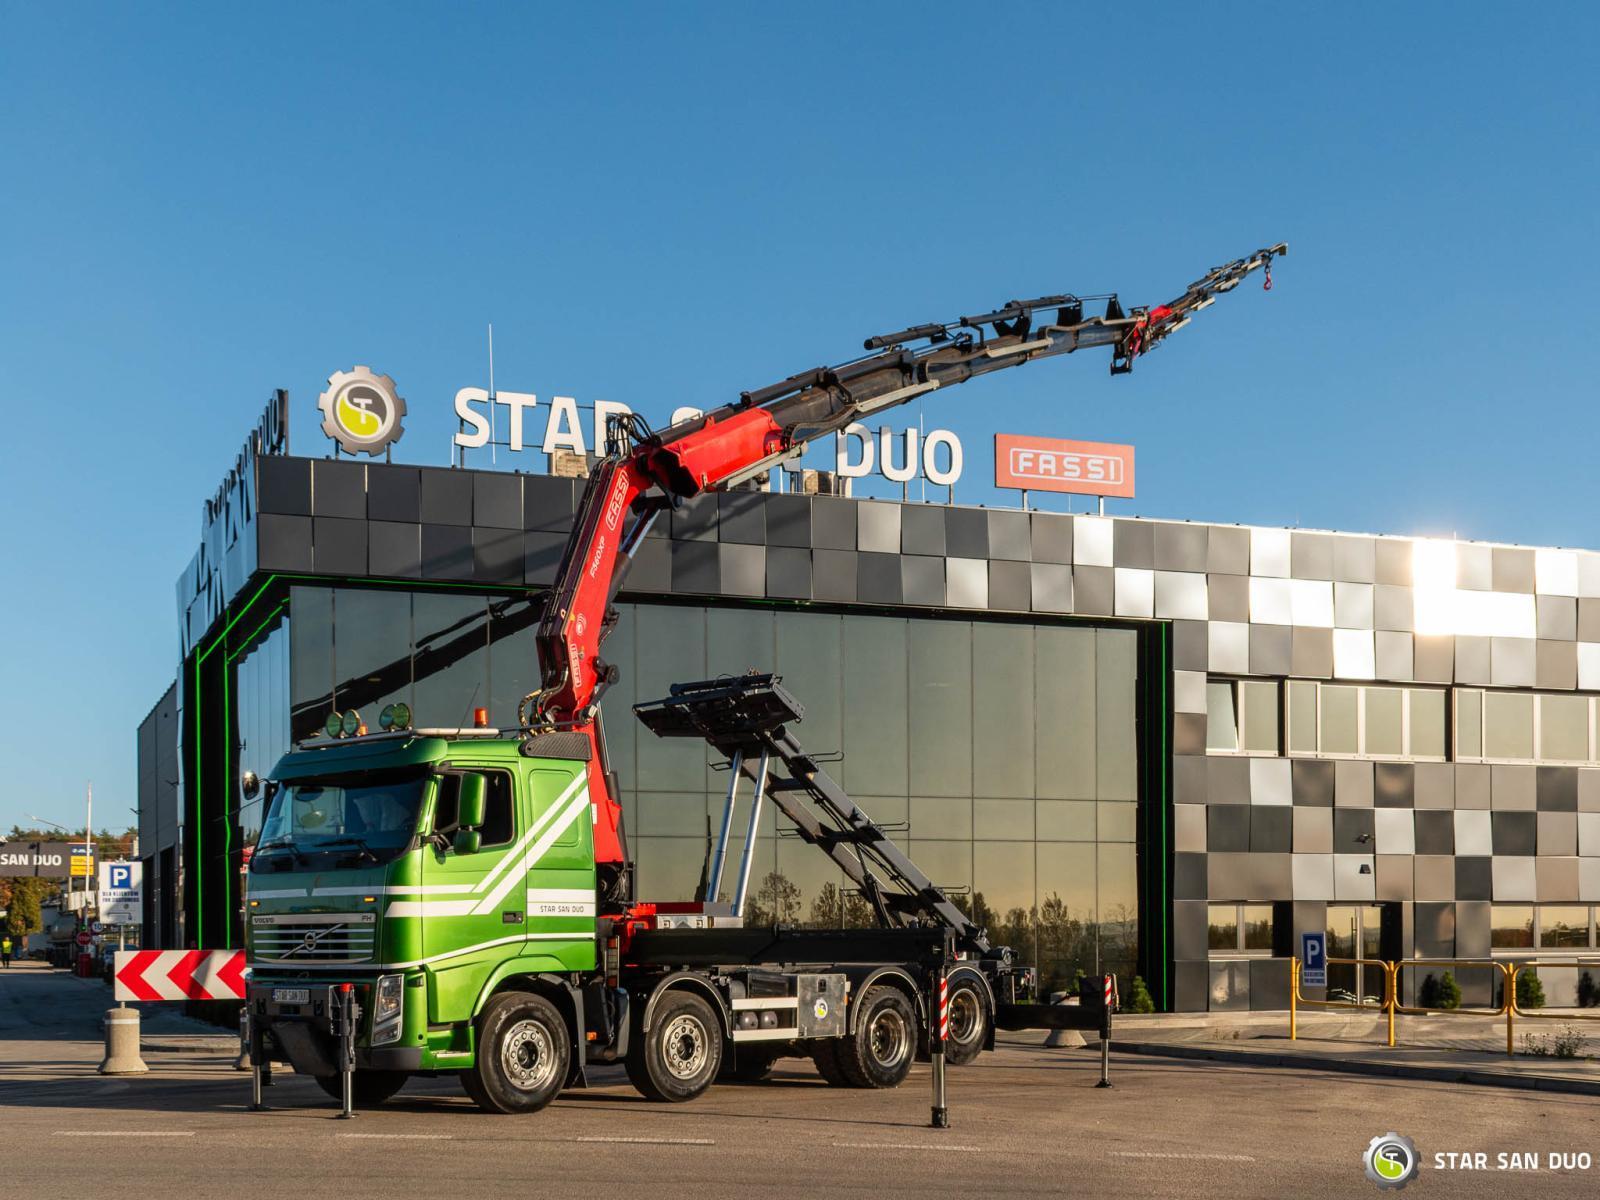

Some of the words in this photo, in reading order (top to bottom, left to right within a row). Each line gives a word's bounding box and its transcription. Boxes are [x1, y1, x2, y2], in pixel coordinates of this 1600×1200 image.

[836, 422, 964, 486] DUO
[1017, 451, 1117, 482] FASSI
[608, 474, 628, 527] FASSI
[0, 853, 29, 866] SAN
[33, 854, 62, 866] DUO
[112, 867, 129, 887] P
[540, 905, 556, 913] STAR
[558, 905, 570, 913] SAN
[572, 905, 584, 913] DUO
[1306, 939, 1320, 965] P
